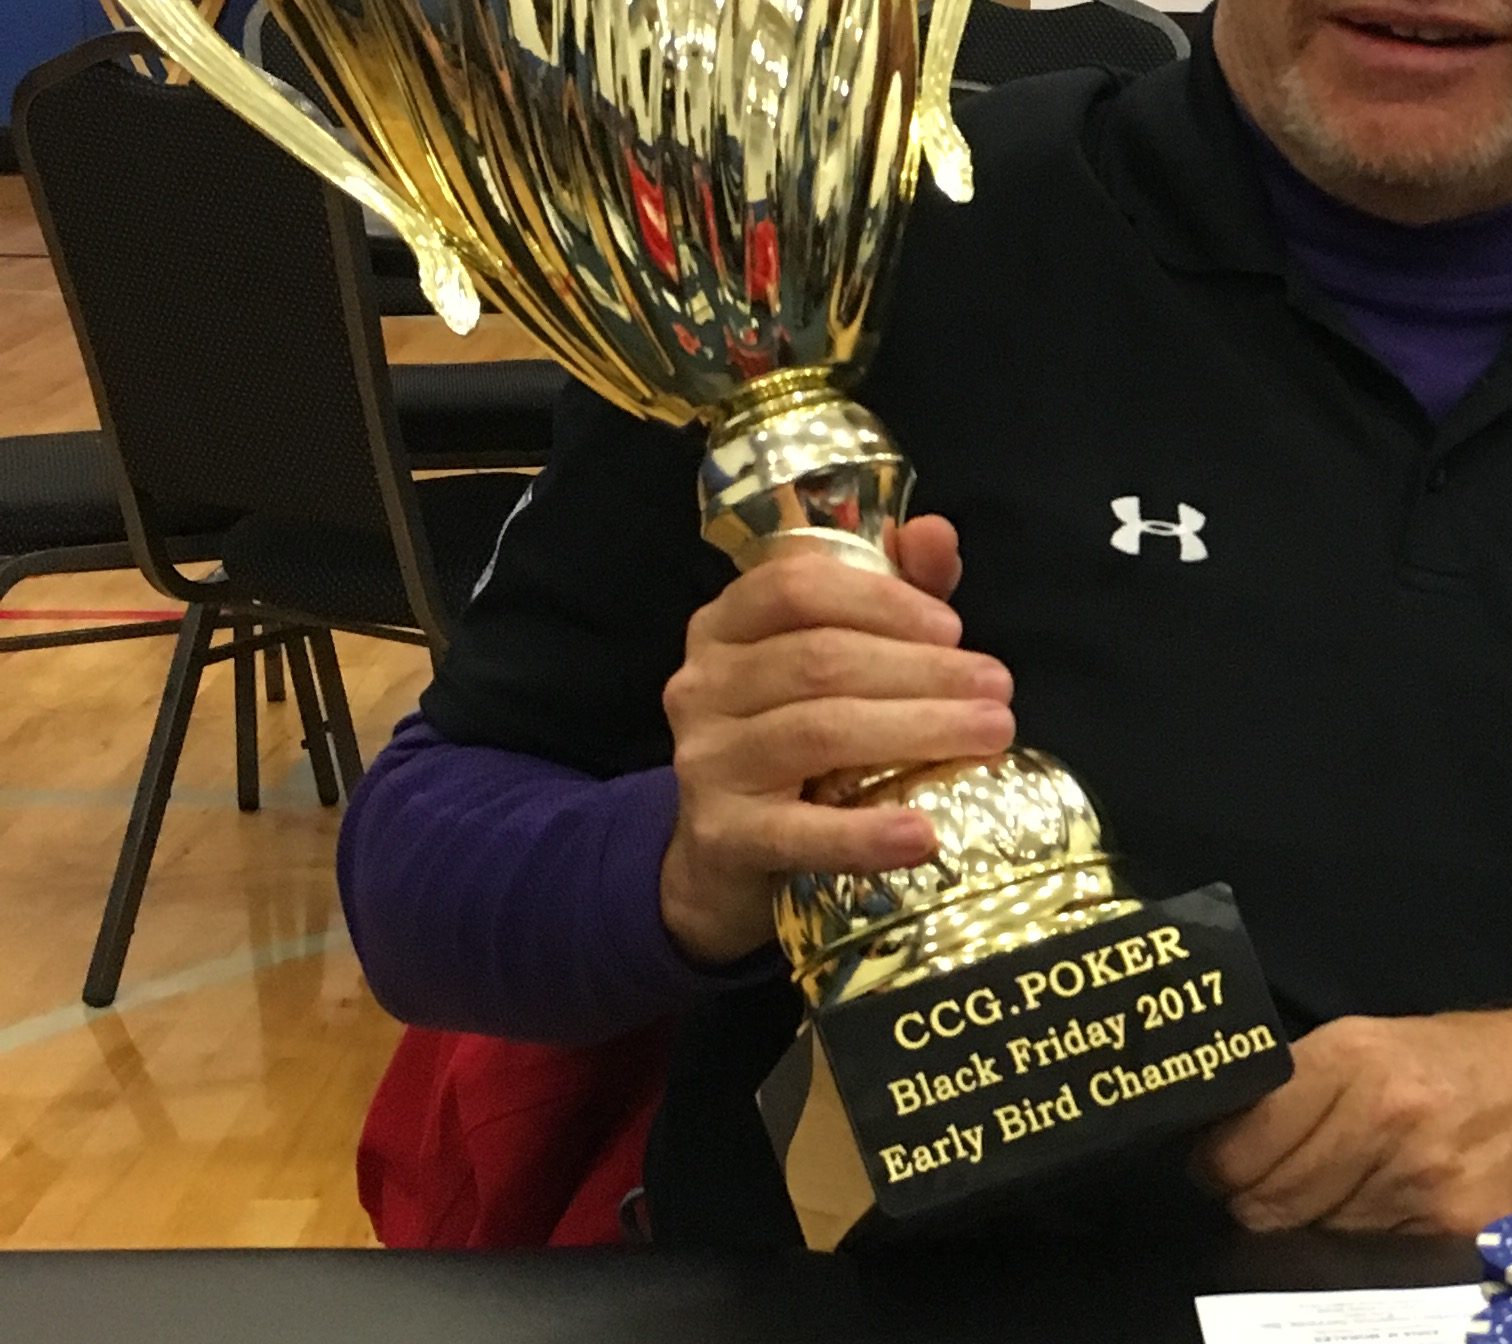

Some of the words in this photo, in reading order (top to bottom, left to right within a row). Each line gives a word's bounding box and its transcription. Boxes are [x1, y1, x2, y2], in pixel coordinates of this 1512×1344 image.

[887, 1052, 1003, 1116] Black
[1006, 1012, 1126, 1074] Friday
[1136, 971, 1224, 1031] 2017
[894, 925, 1190, 1050] CCG.POKER
[879, 1123, 985, 1184] Early
[993, 1084, 1082, 1145] Bird
[1089, 1023, 1277, 1109] Champion
